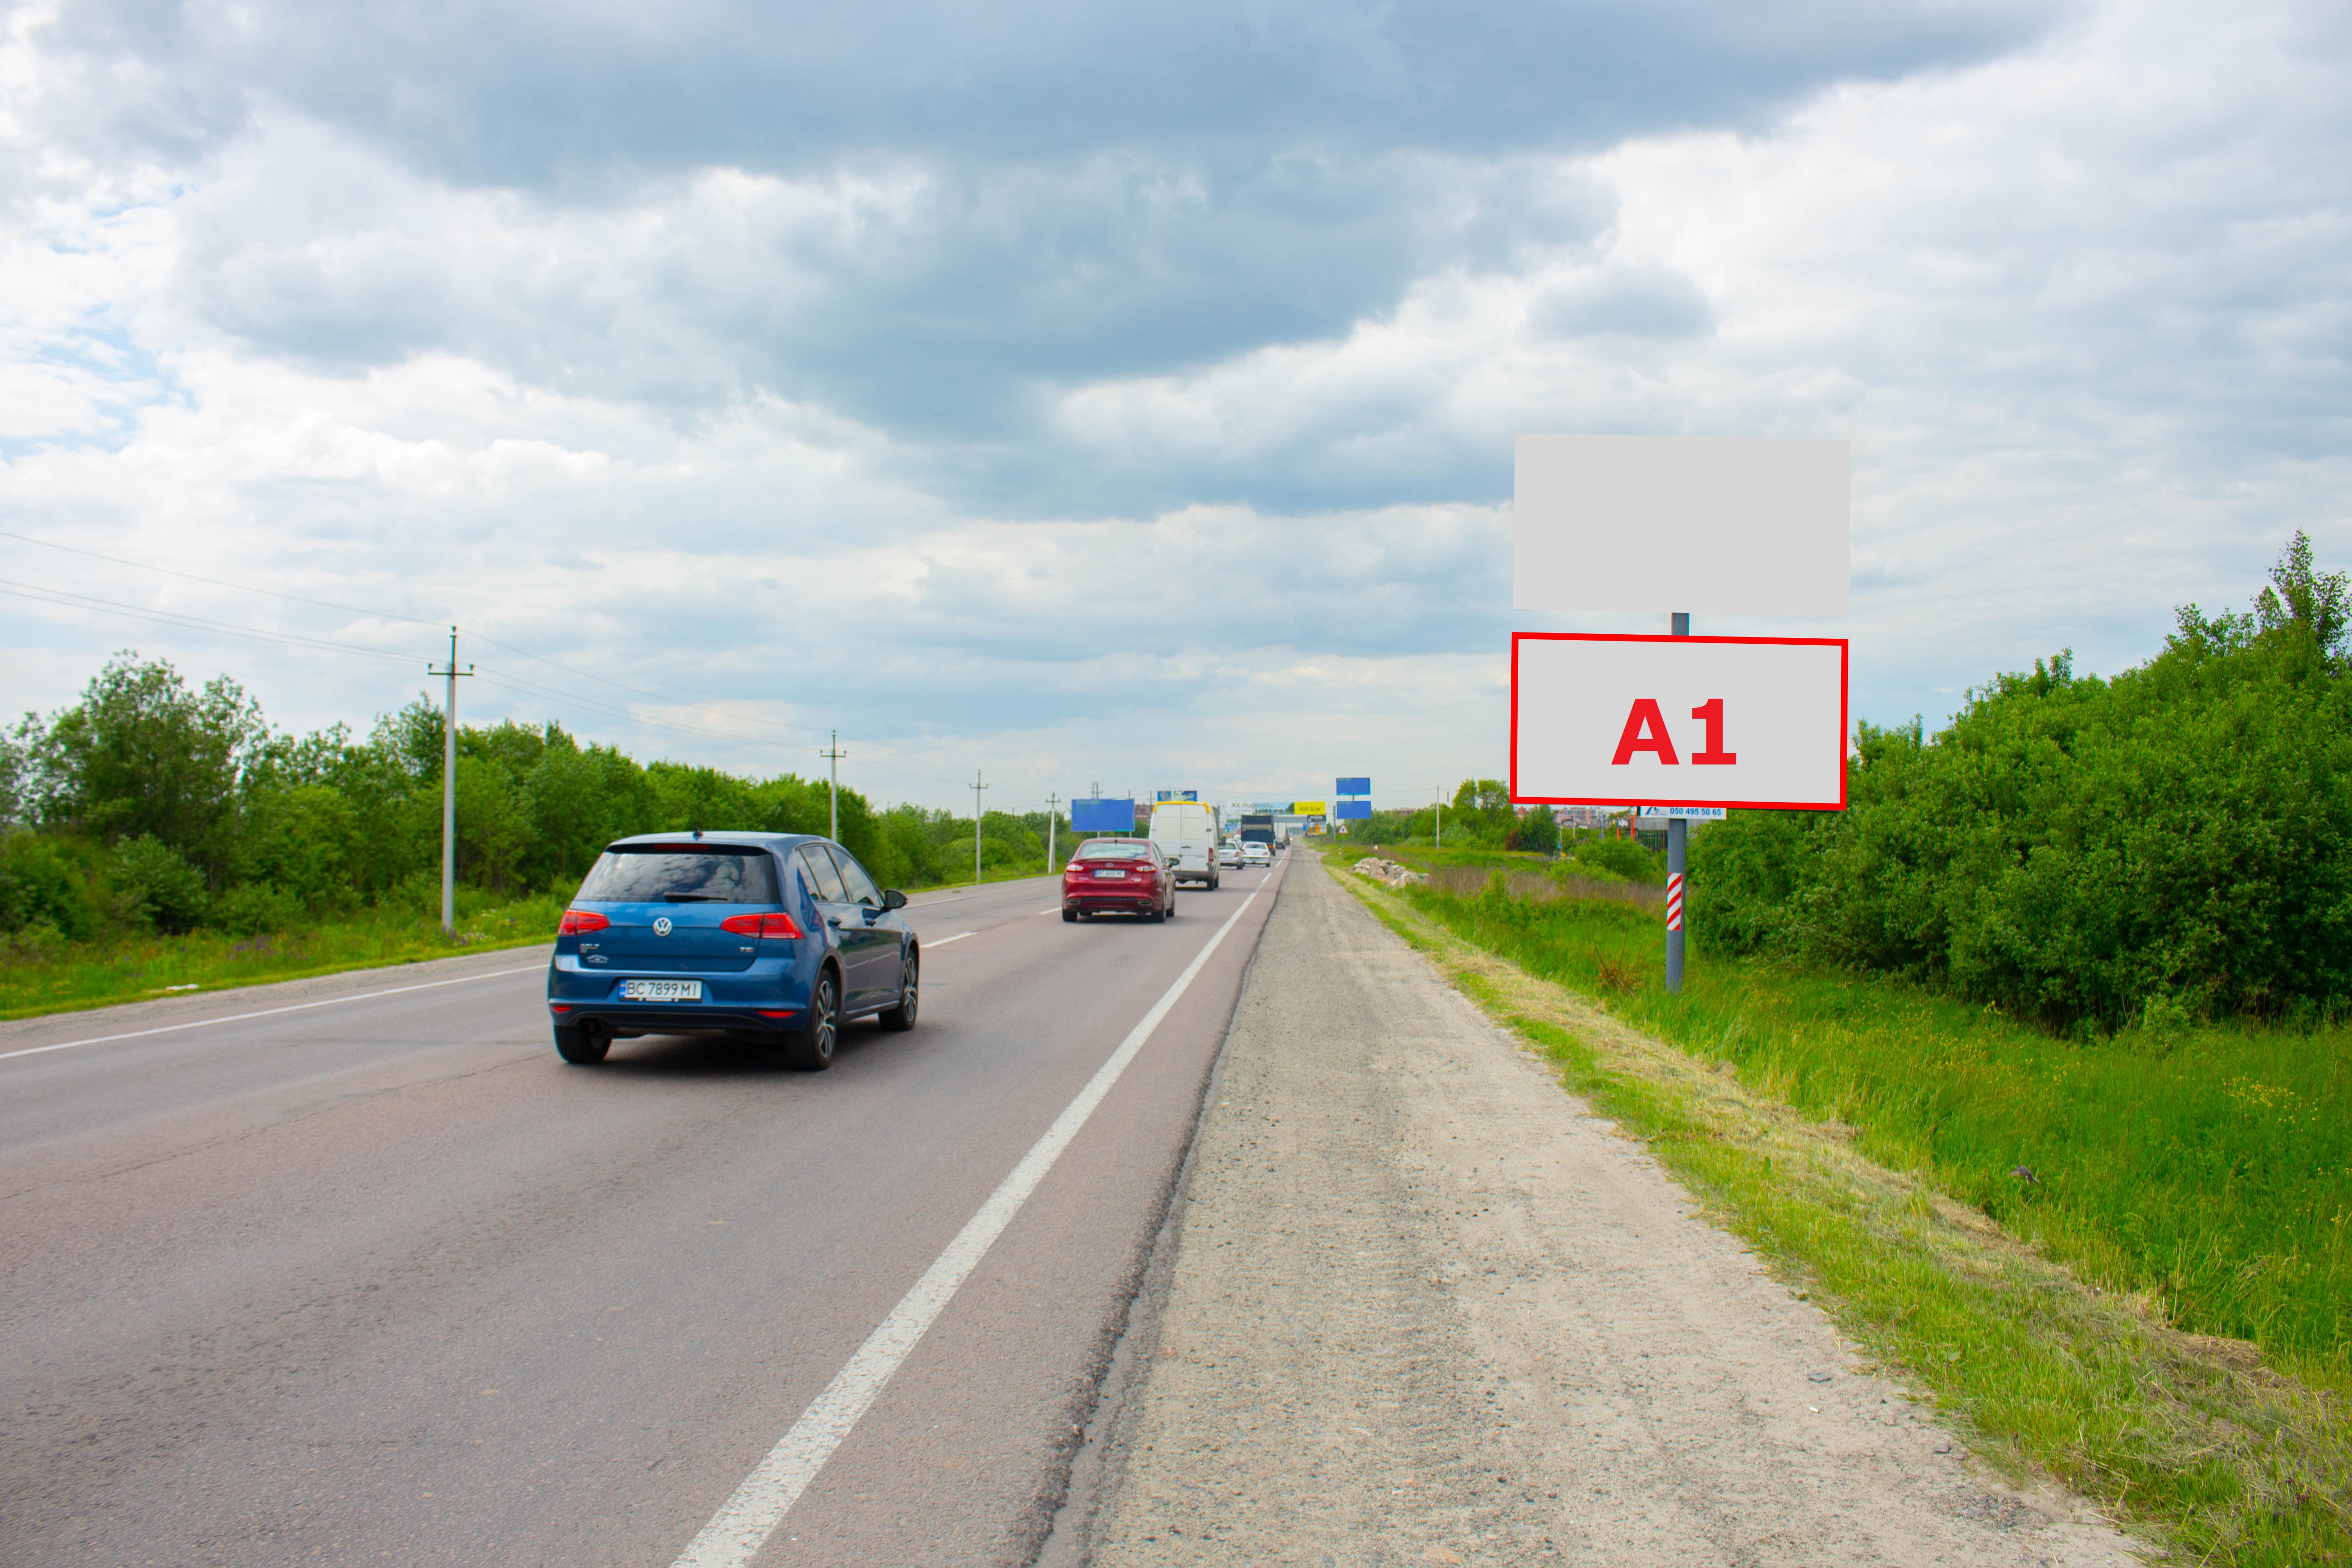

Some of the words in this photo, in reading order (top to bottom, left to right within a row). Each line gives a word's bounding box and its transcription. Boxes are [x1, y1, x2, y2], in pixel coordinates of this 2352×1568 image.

[627, 982, 645, 995] BC
[649, 982, 678, 995] 7899
[681, 983, 697, 996] MI
